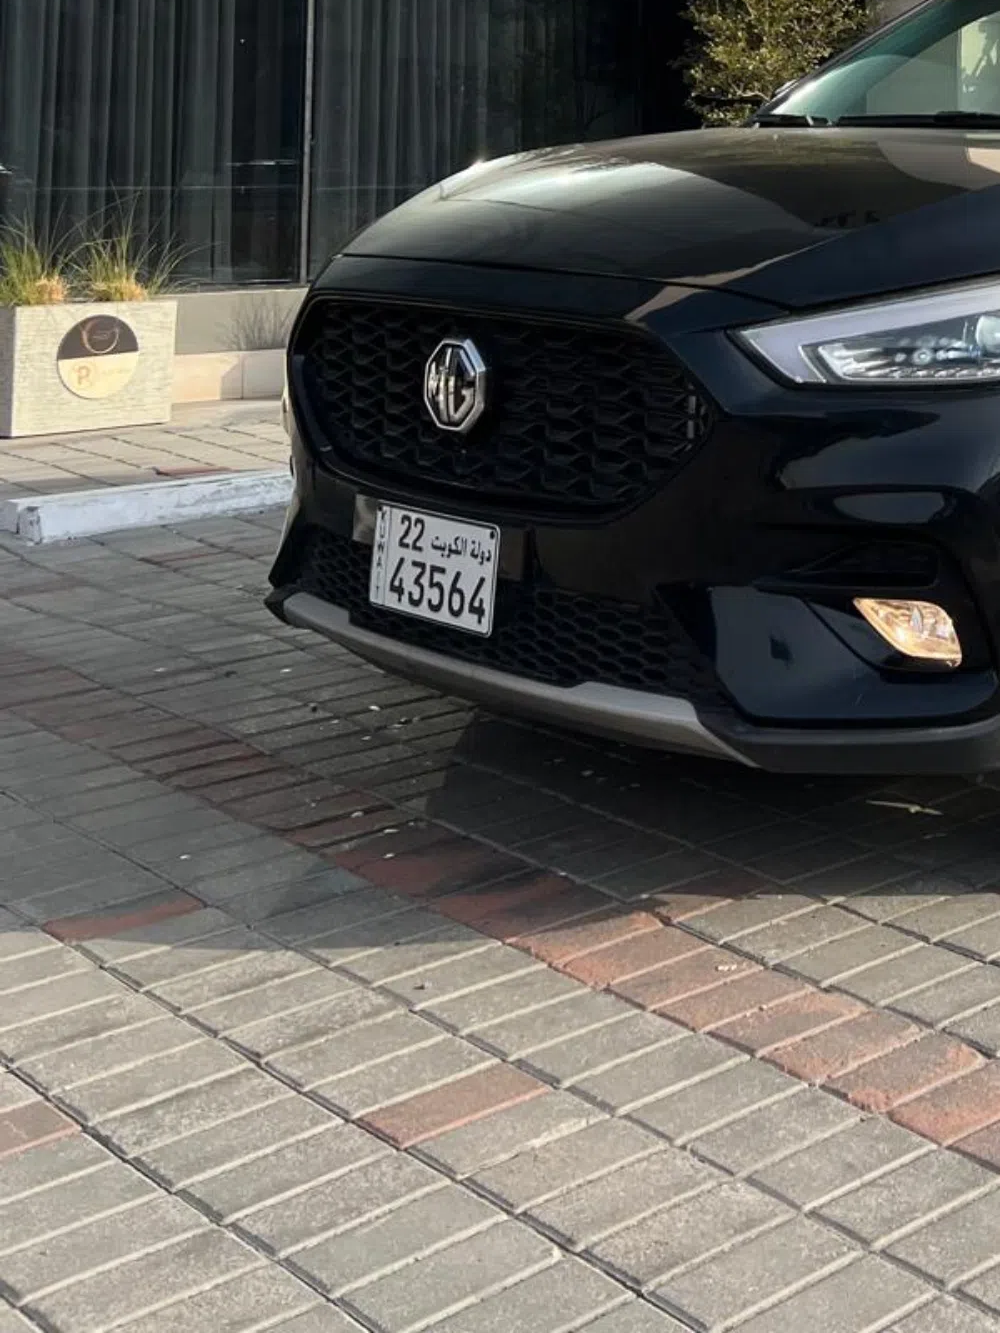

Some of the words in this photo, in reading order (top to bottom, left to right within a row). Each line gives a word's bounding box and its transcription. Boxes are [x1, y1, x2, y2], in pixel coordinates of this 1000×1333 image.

[427, 346, 476, 424] MG
[398, 514, 425, 552] 22
[431, 535, 468, 559] الكويت
[389, 557, 486, 625] 43564
